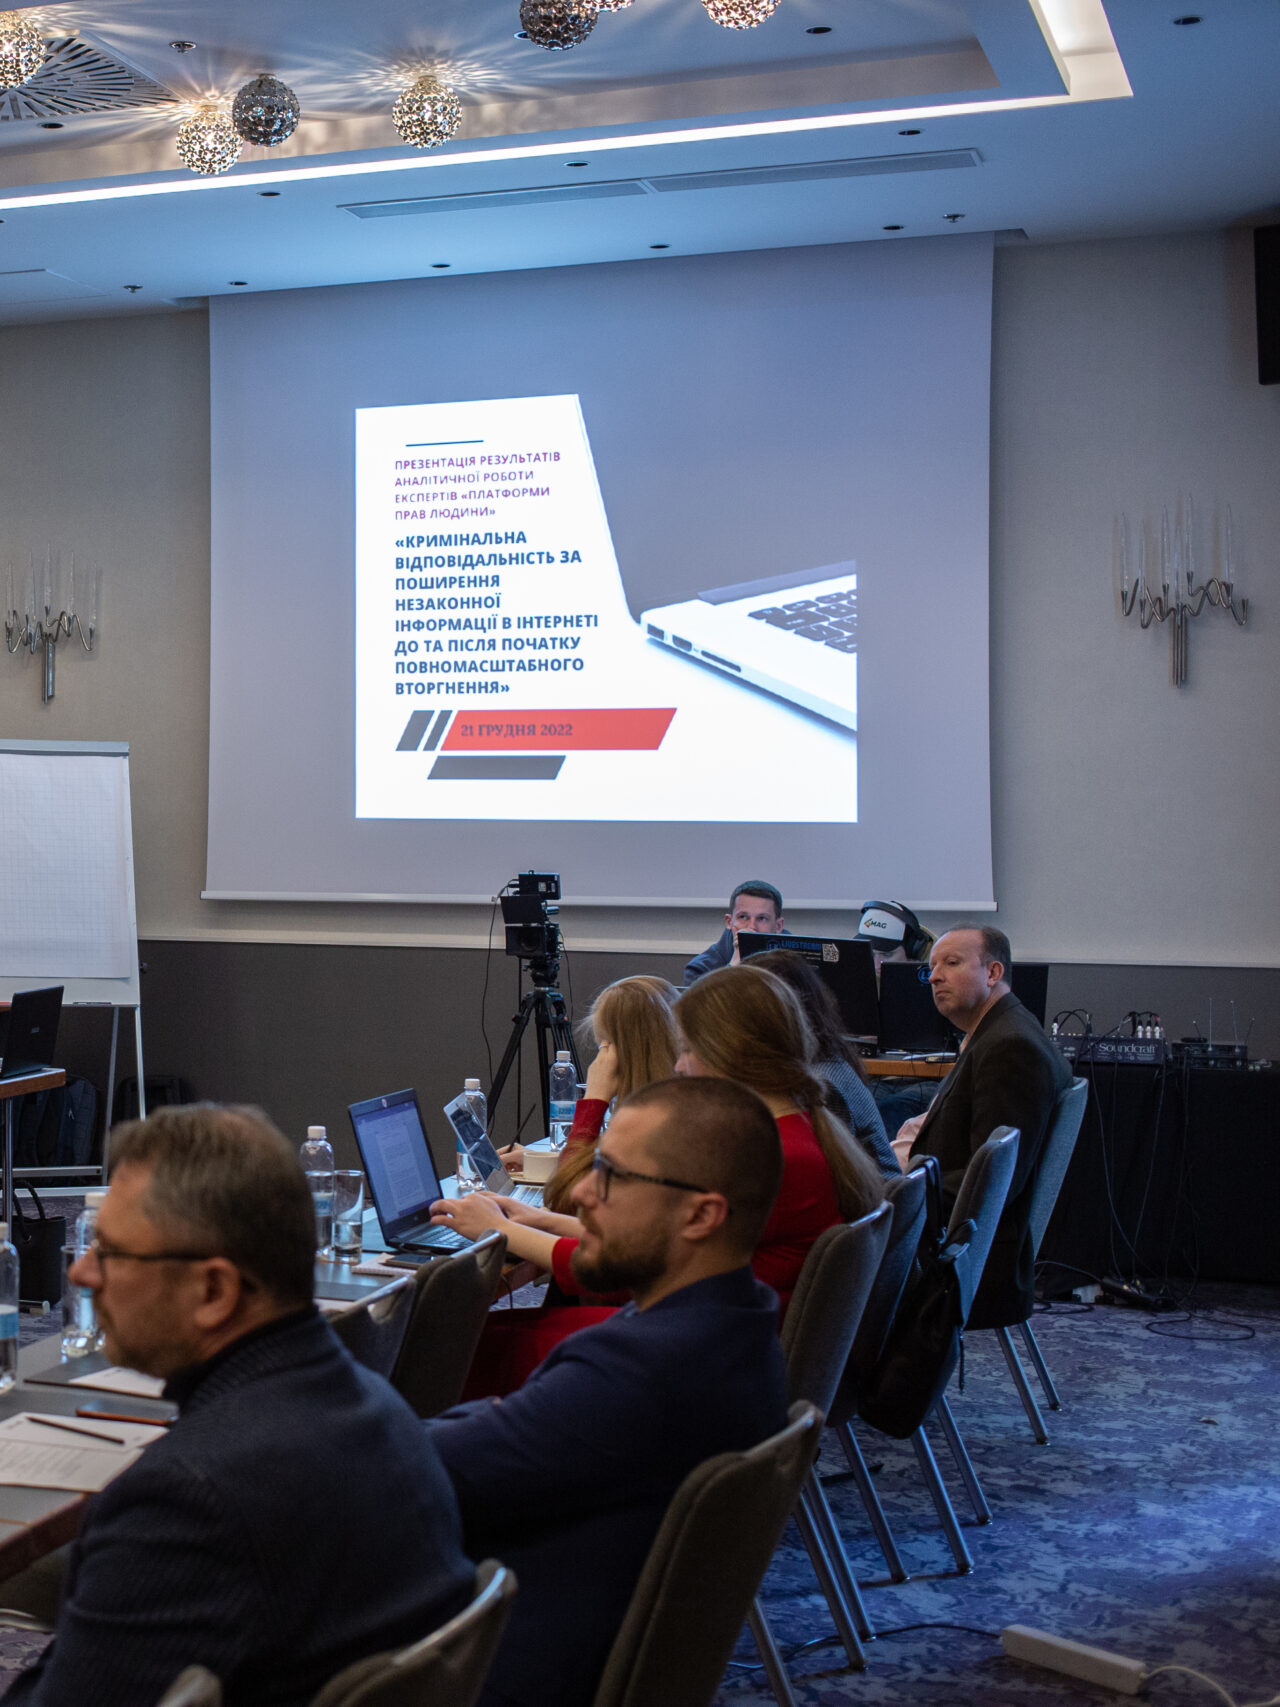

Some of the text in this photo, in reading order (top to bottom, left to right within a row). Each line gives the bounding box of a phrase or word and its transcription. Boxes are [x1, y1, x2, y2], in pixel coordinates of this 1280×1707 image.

[395, 452, 560, 470] ПРЕЗЕНТАЦІЯ РЕЗУЛЬТАТІВ
[395, 471, 533, 486] АНАЛІТИЧНОЇ РОБОТИ
[396, 487, 549, 503] ЕКСПЕРТІВ «ПЛАТФОРМИ
[396, 507, 495, 520] ПРАВ ЛЮДИНИ»
[395, 531, 527, 548] «КРИМІНАЛЬНА
[396, 550, 582, 572] ВІДПОВІДАЛЬНІСТЬ ЗА
[396, 574, 500, 590] ПОШИРЕННЯ
[396, 592, 502, 611] НЕЗАКОННОЇ
[396, 614, 598, 633] ІНФОРМАЦІЇ В ІНТЕРНЕТІ
[394, 636, 581, 656] ДО ТА ПІСЛЯ ПОЧАТКУ
[396, 658, 584, 674] ПОВНОМАСШТАБНОГО
[396, 681, 510, 695] ВТОРГНЕННЯ»
[462, 724, 572, 737] 21 ГРУДНЯ 2022
